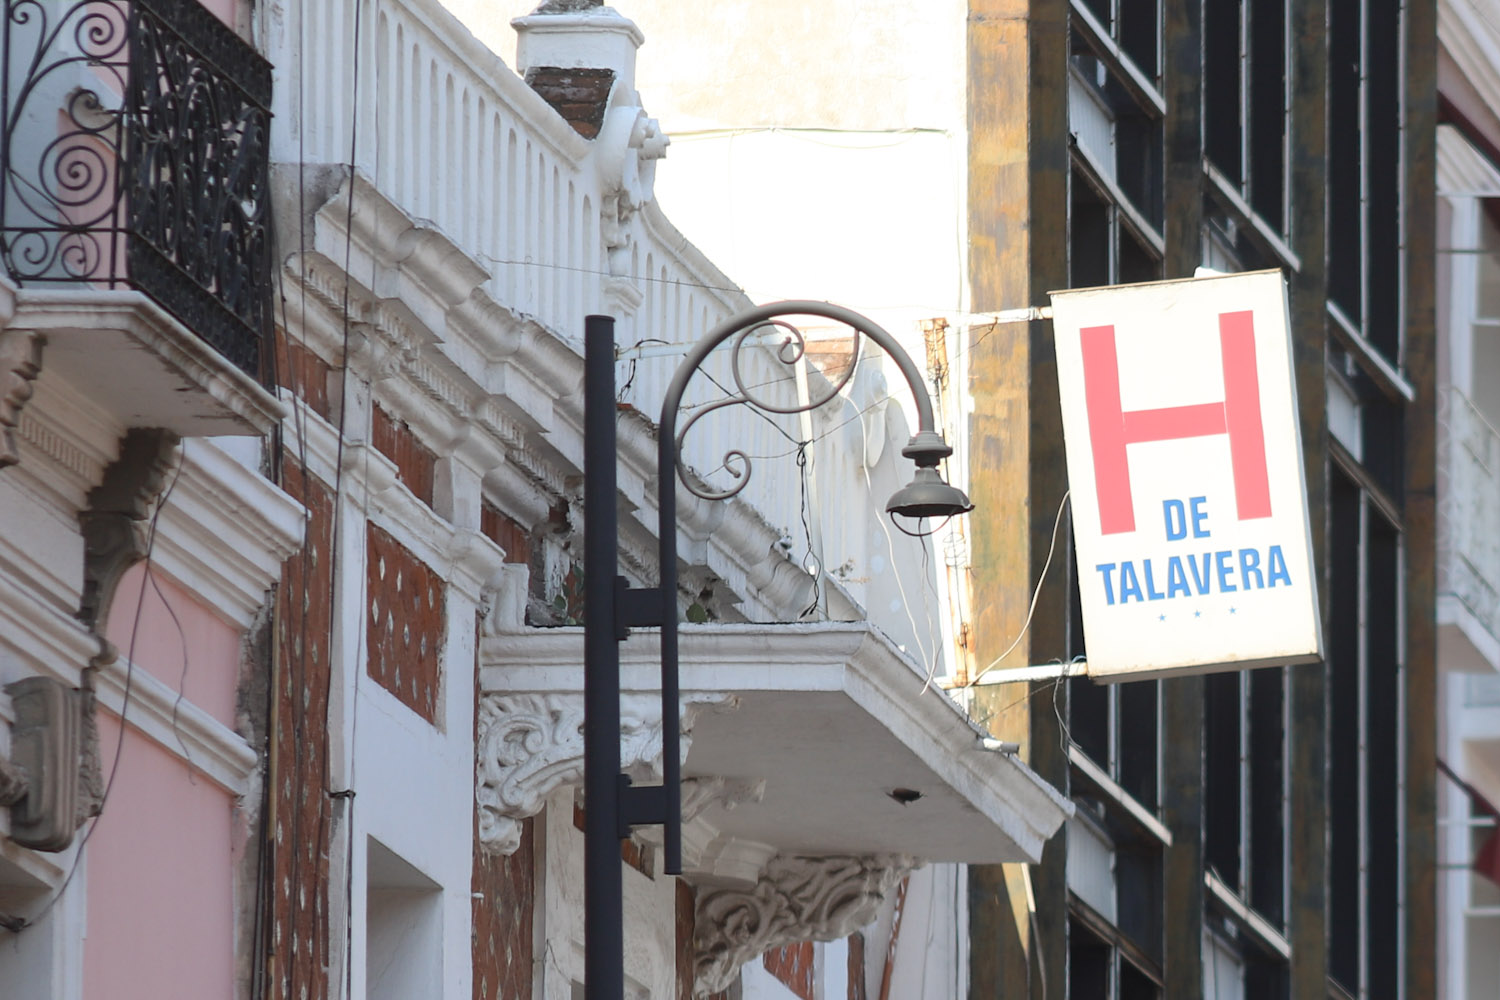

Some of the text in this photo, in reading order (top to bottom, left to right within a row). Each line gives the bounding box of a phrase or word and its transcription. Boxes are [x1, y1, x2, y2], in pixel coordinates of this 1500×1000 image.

[1079, 310, 1272, 536] H
[1163, 495, 1211, 542] DE
[1095, 545, 1293, 606] TALAVERA
